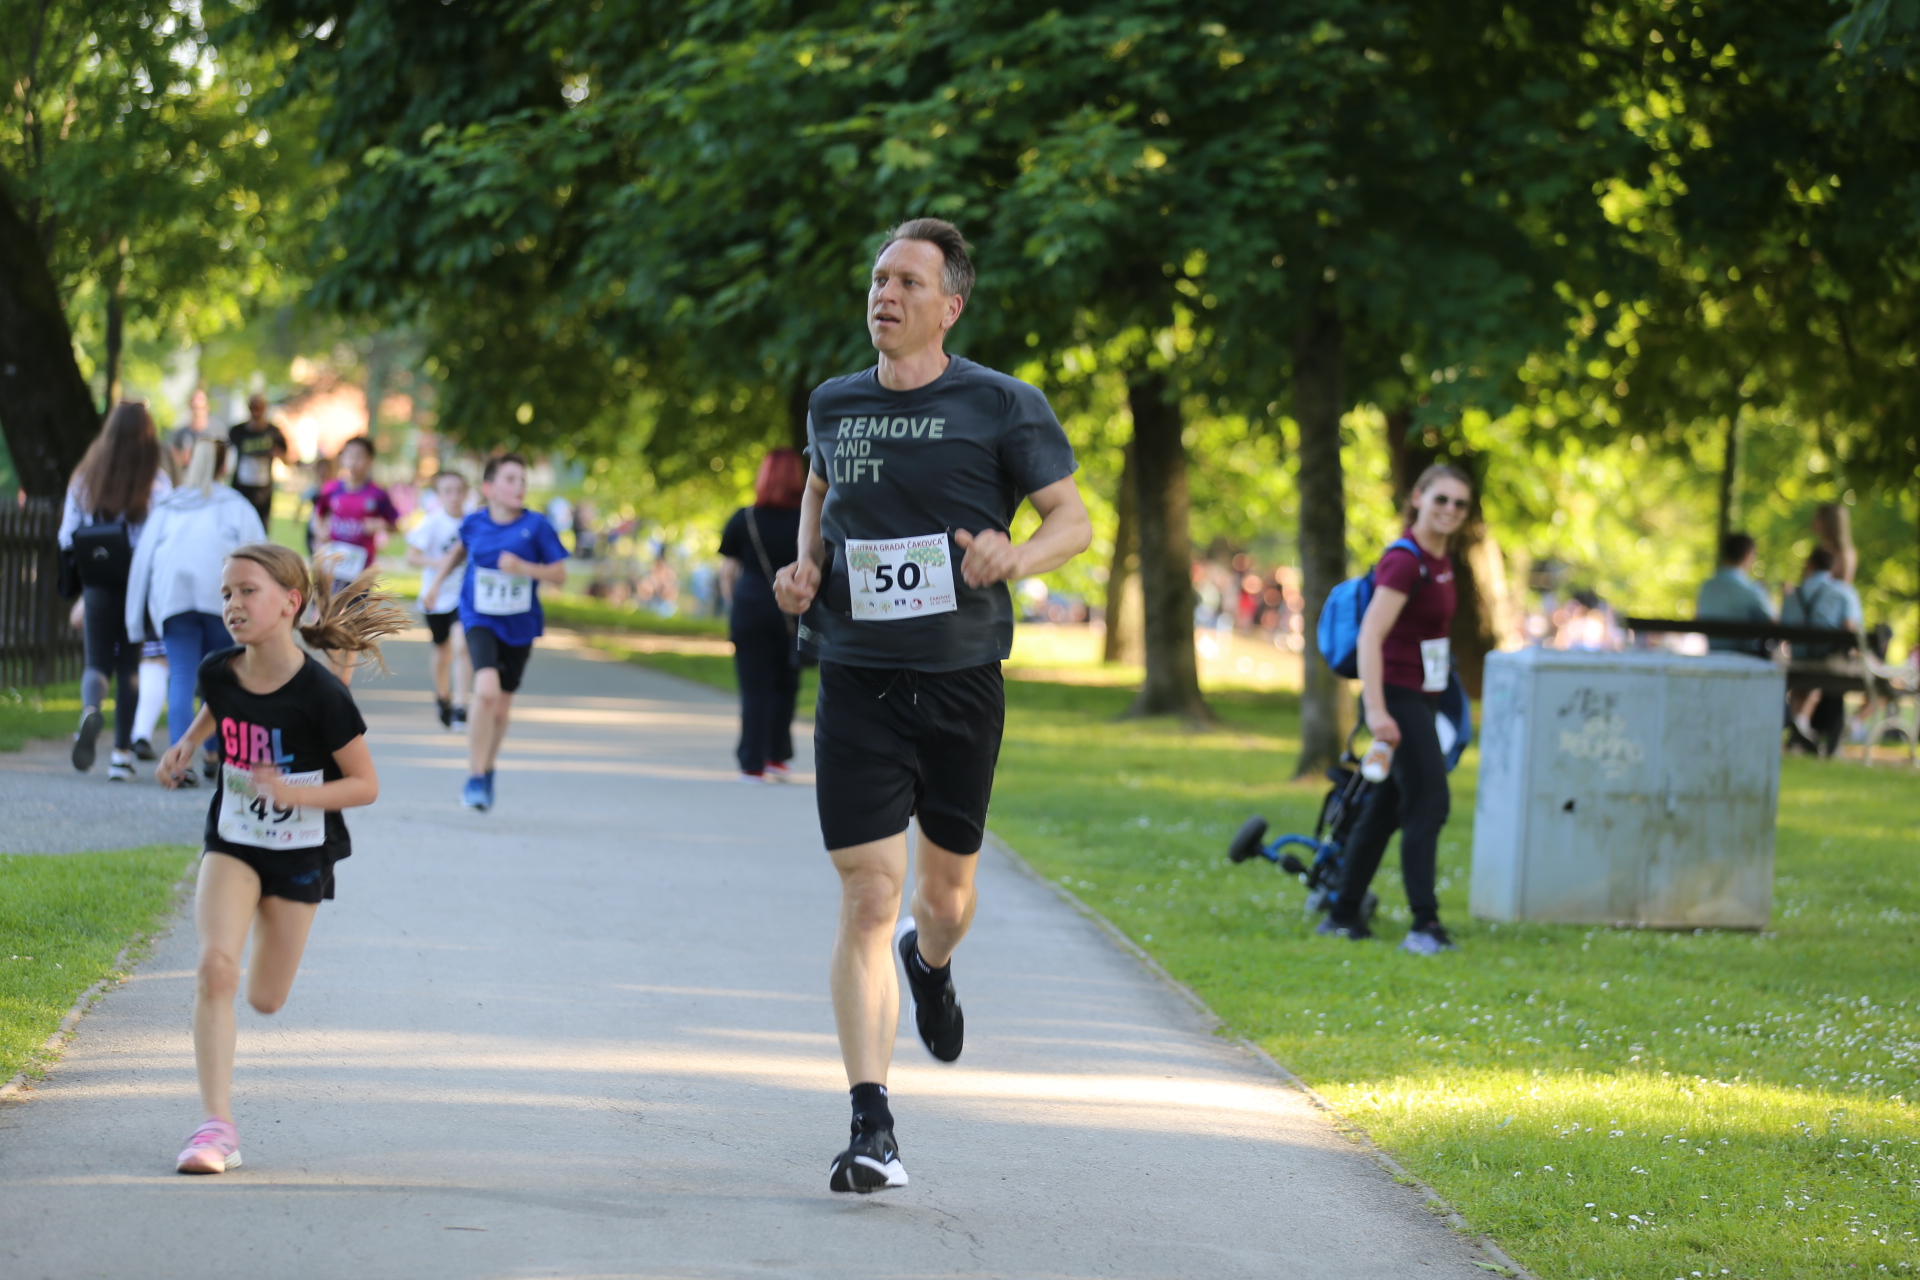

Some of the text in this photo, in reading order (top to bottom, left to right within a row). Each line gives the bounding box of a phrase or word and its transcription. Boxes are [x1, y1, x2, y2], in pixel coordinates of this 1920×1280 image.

[836, 416, 946, 439] REMOVE
[834, 439, 871, 458] AND
[834, 458, 883, 483] LIFT
[879, 543, 906, 552] GRADA
[907, 537, 943, 550] ČAKOVCA
[875, 562, 921, 593] 50
[222, 716, 295, 765] GIRL
[249, 795, 295, 823] 49
